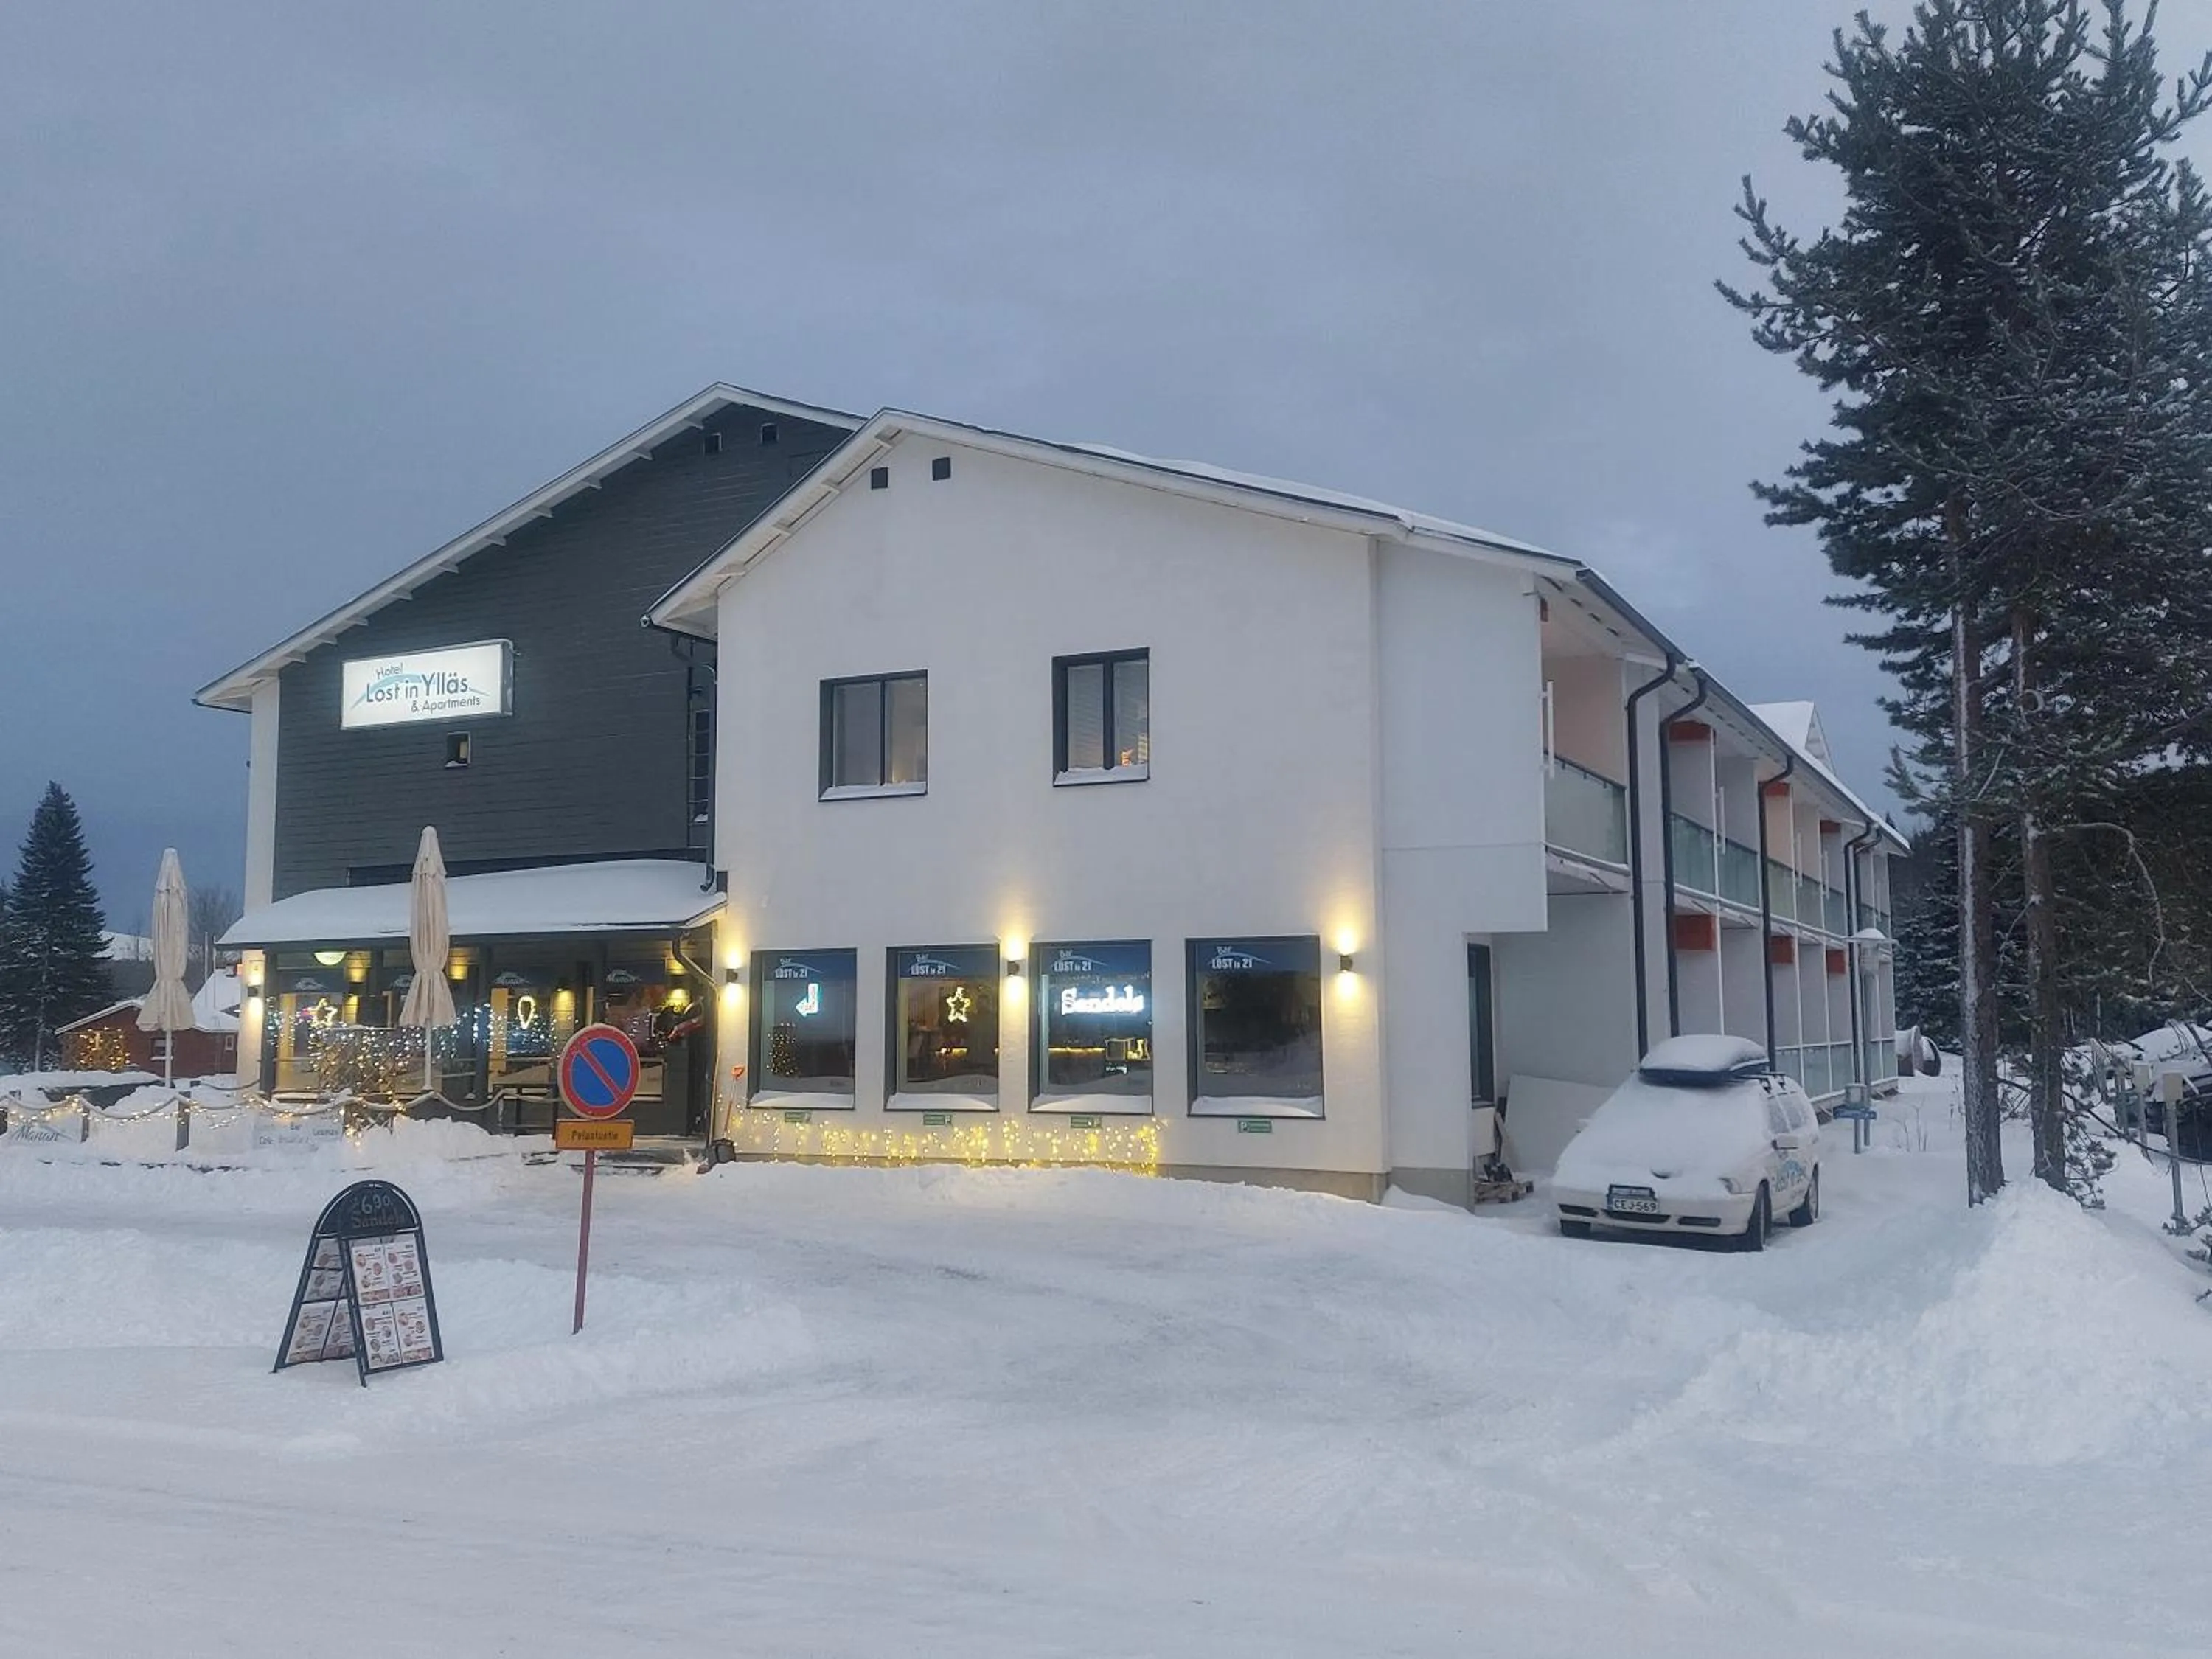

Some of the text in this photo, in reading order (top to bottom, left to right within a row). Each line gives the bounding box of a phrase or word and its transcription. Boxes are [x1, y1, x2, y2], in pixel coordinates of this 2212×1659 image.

[376, 662, 403, 680] Hotel
[366, 672, 468, 703] Lost in Ylläs
[411, 695, 481, 714] & Apartments
[911, 964, 929, 975] LOST
[1054, 961, 1074, 972] LOST
[1082, 961, 1092, 971] 21
[1211, 958, 1234, 970] LOST
[1242, 958, 1253, 969] 21
